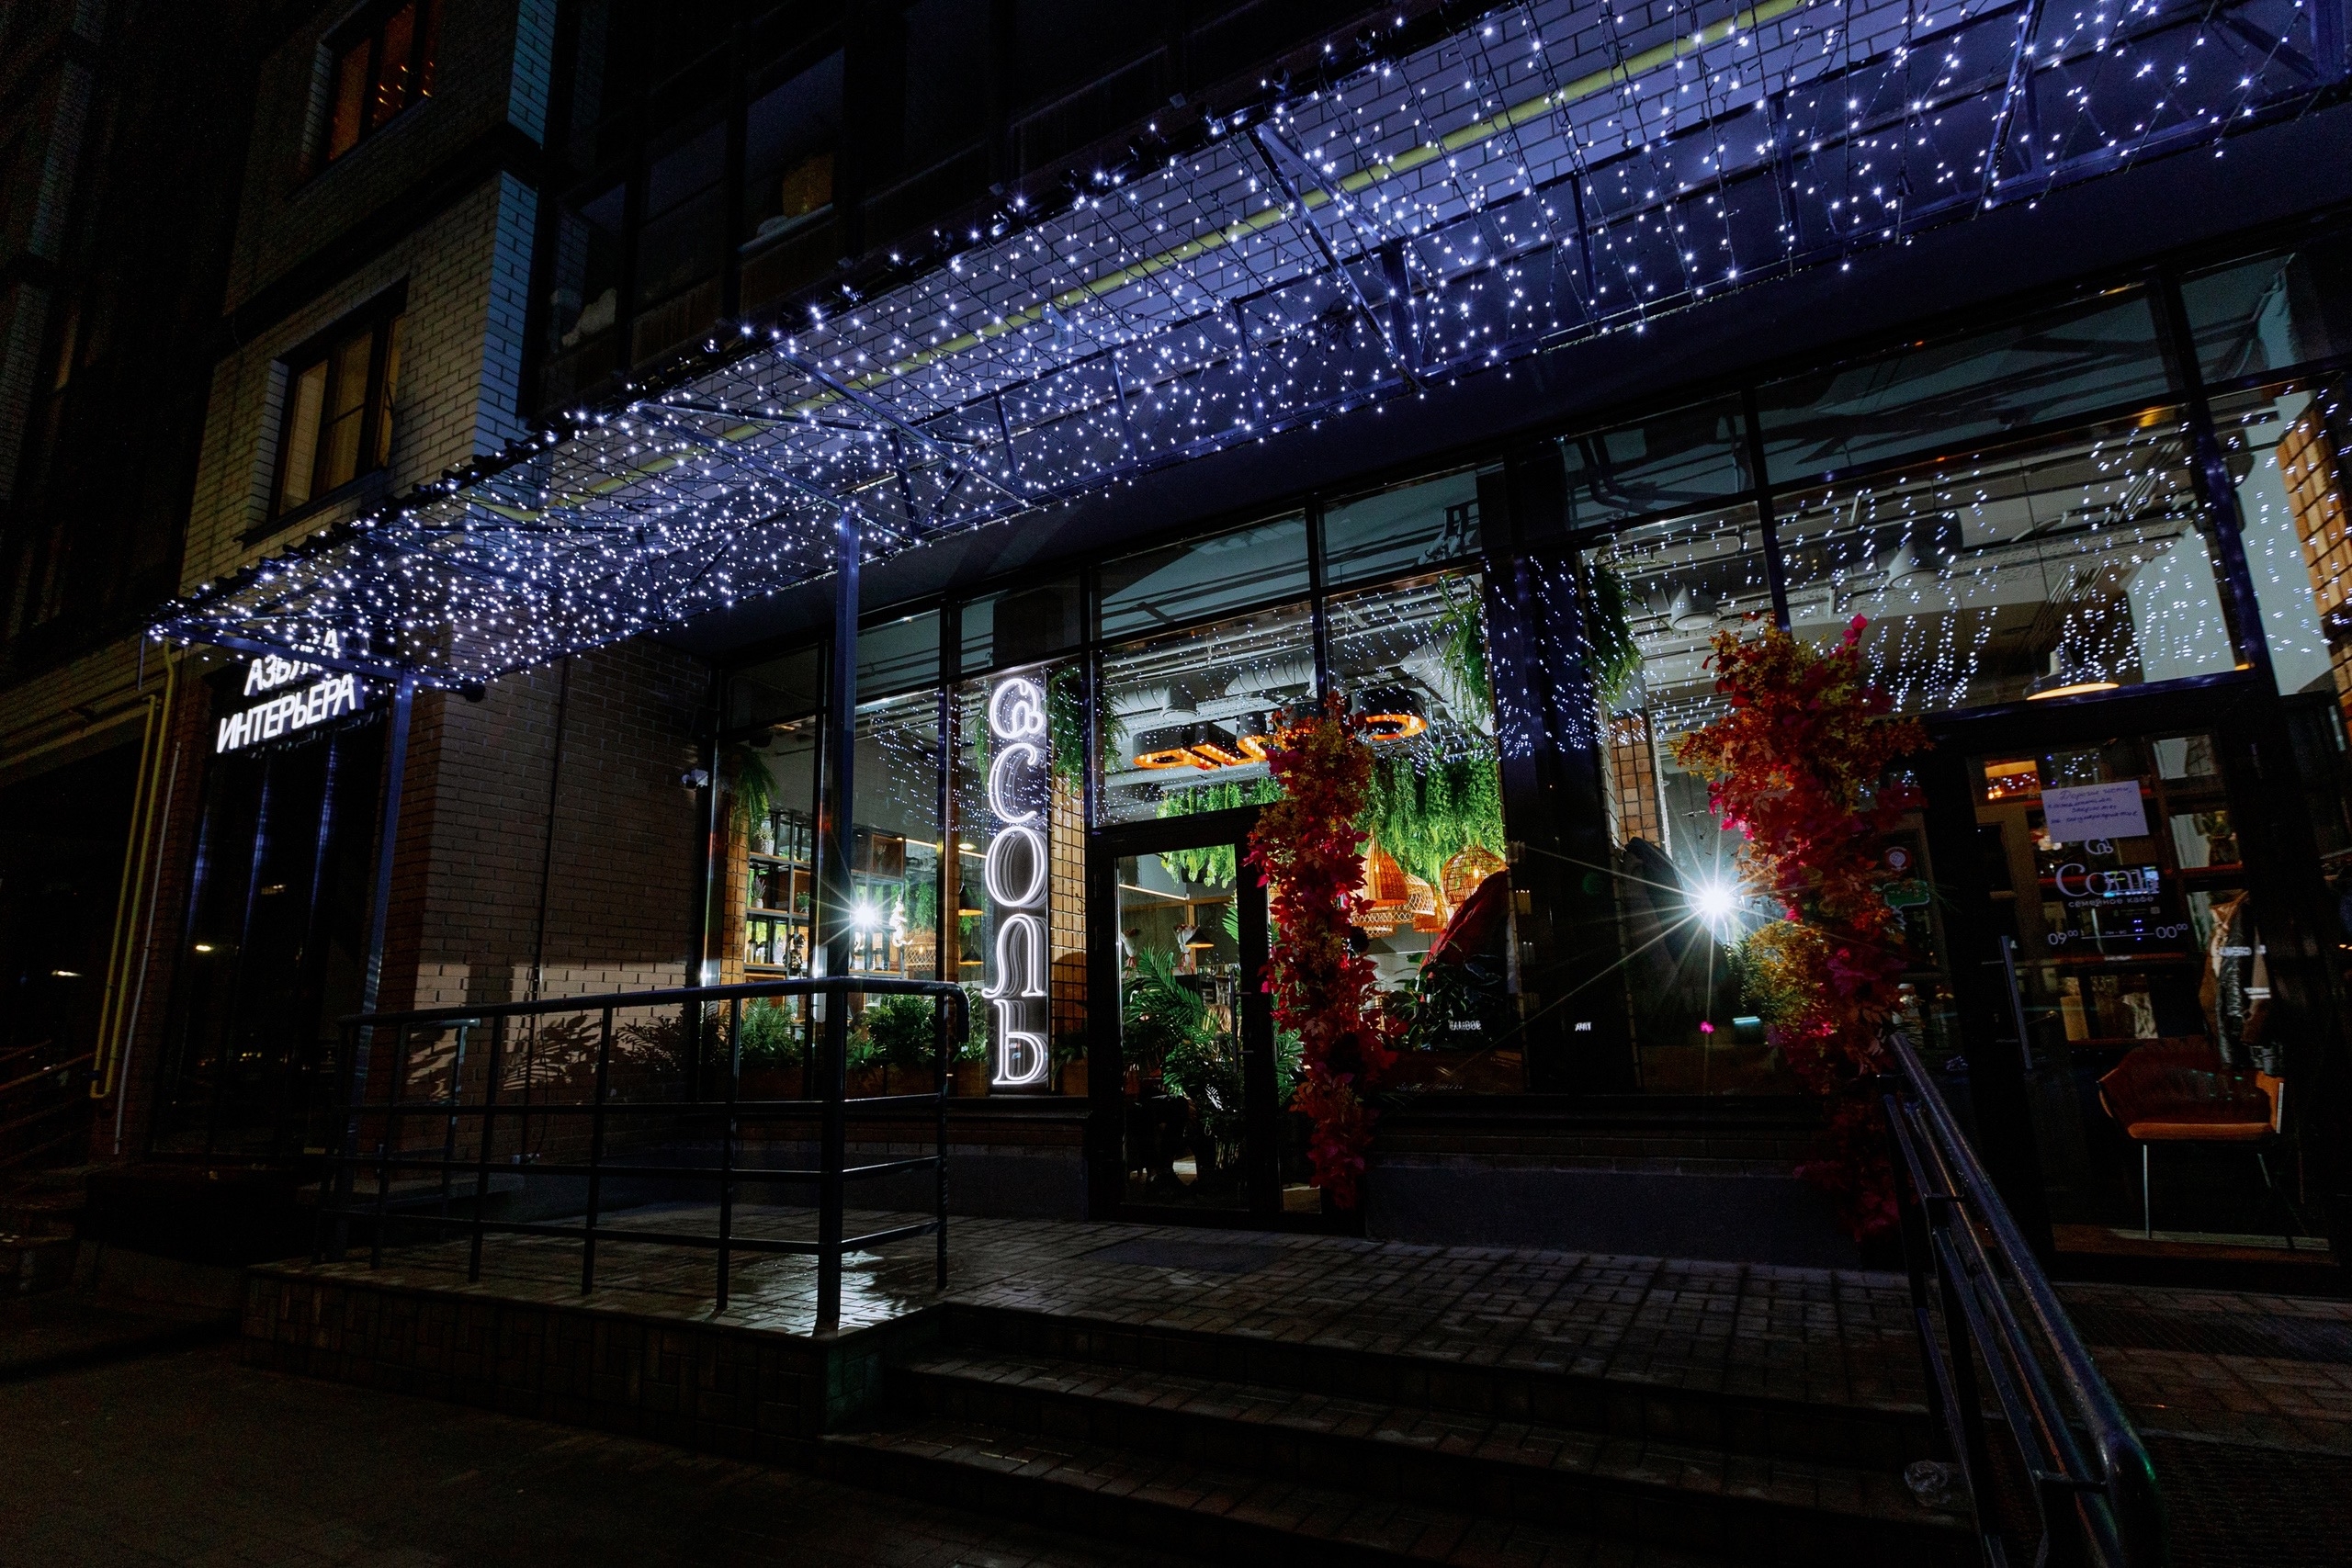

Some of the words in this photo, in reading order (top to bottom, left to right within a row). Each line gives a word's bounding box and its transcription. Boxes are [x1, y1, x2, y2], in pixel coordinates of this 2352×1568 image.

[216, 673, 356, 753] ИНТЕРЬЕРА
[2067, 897, 2124, 908] семейное
[2126, 896, 2154, 905] кафе
